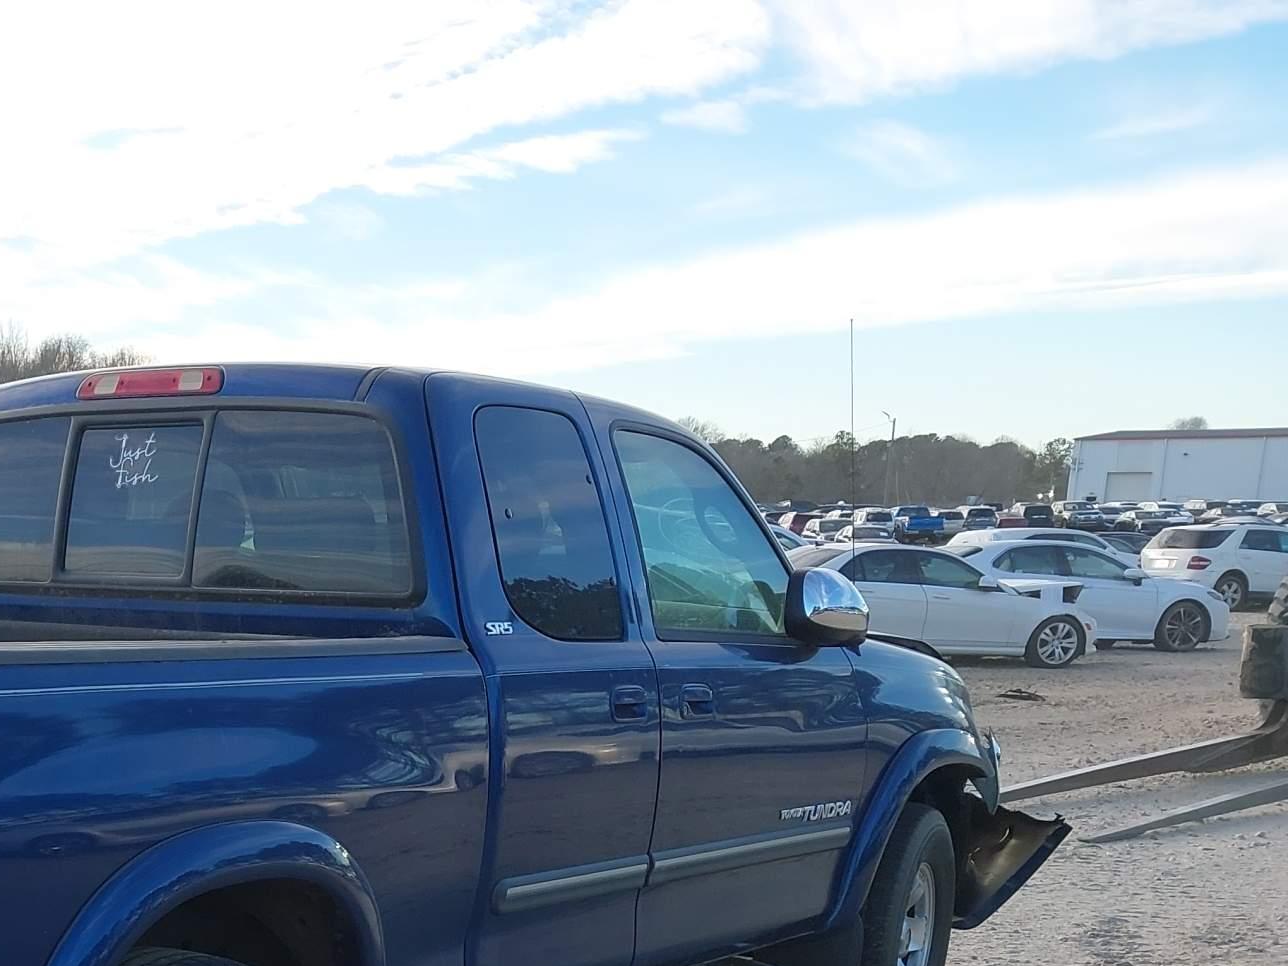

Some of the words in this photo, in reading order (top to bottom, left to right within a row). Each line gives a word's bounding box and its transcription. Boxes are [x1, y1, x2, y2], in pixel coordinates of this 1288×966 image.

[109, 432, 157, 468] Just
[485, 621, 514, 636] SR5
[802, 800, 852, 822] TUNDRA
